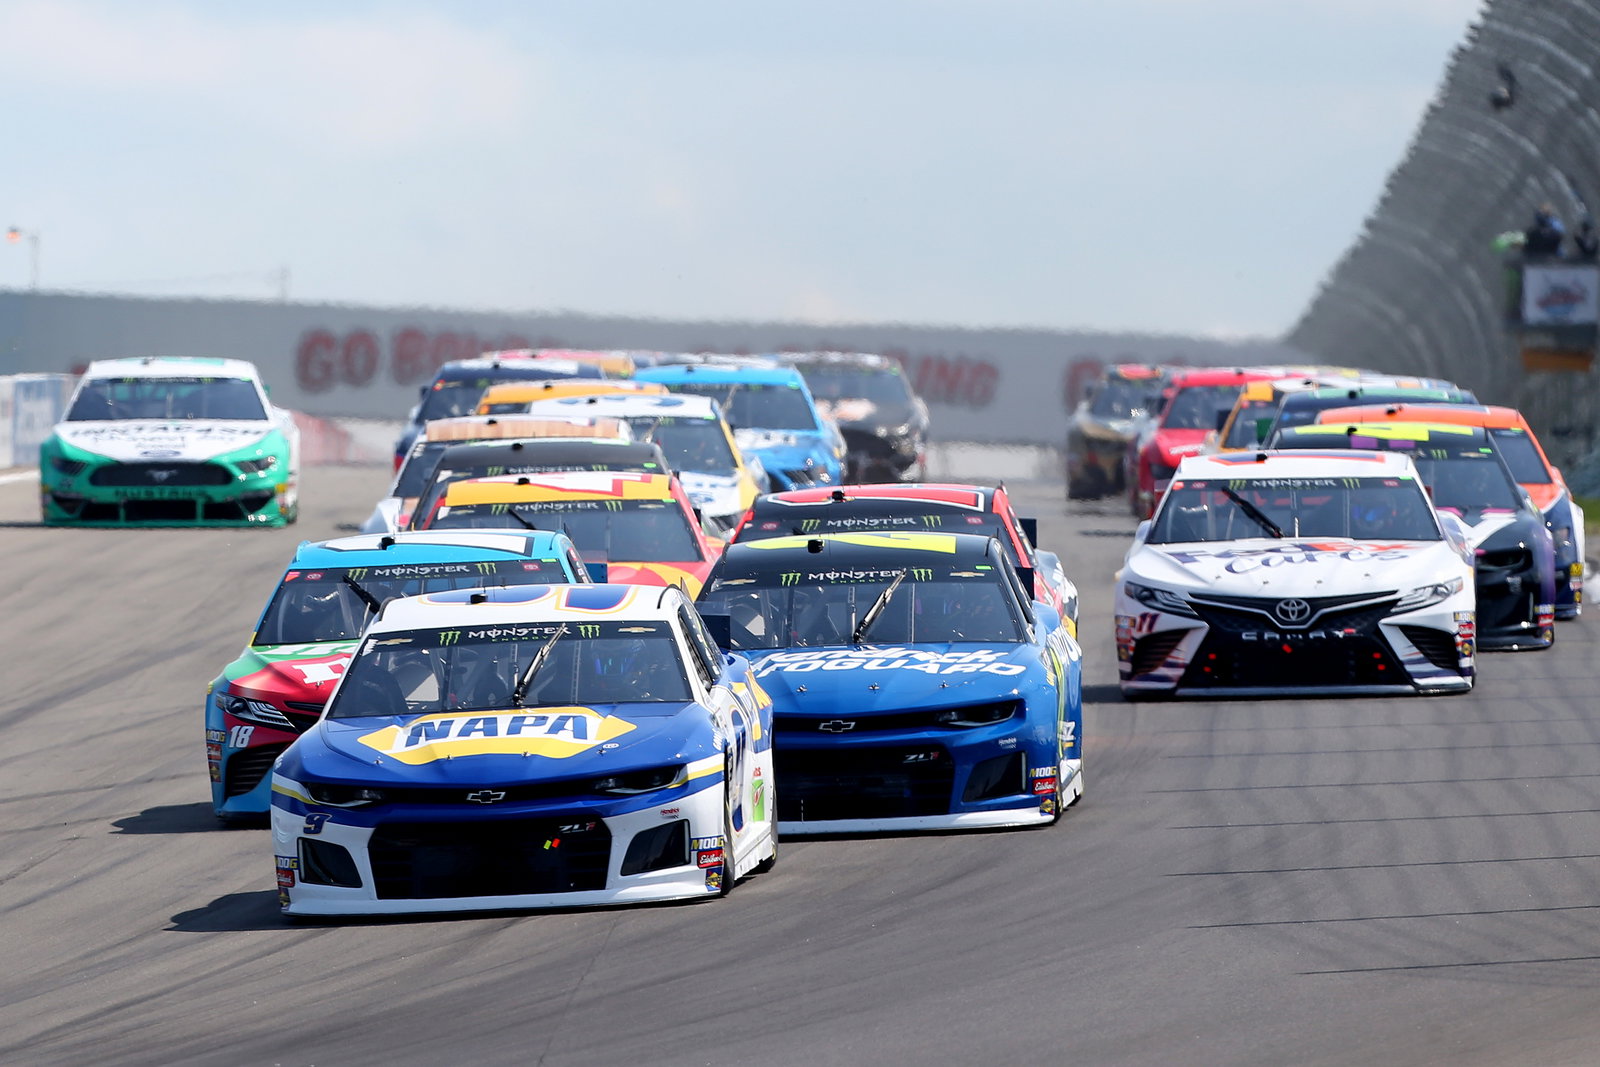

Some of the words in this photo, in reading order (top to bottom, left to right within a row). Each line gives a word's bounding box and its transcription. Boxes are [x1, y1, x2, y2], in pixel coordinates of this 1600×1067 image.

[295, 326, 380, 392] GO
[1252, 477, 1337, 489] MONSTER
[514, 501, 600, 512] MONSTER
[826, 516, 917, 528] MONSTER
[374, 564, 471, 577] MONSTER
[228, 725, 255, 748] 18
[404, 715, 589, 748] NAPA
[1029, 766, 1057, 778] MOOG
[303, 813, 333, 835] 9
[691, 836, 725, 850] MOOG
